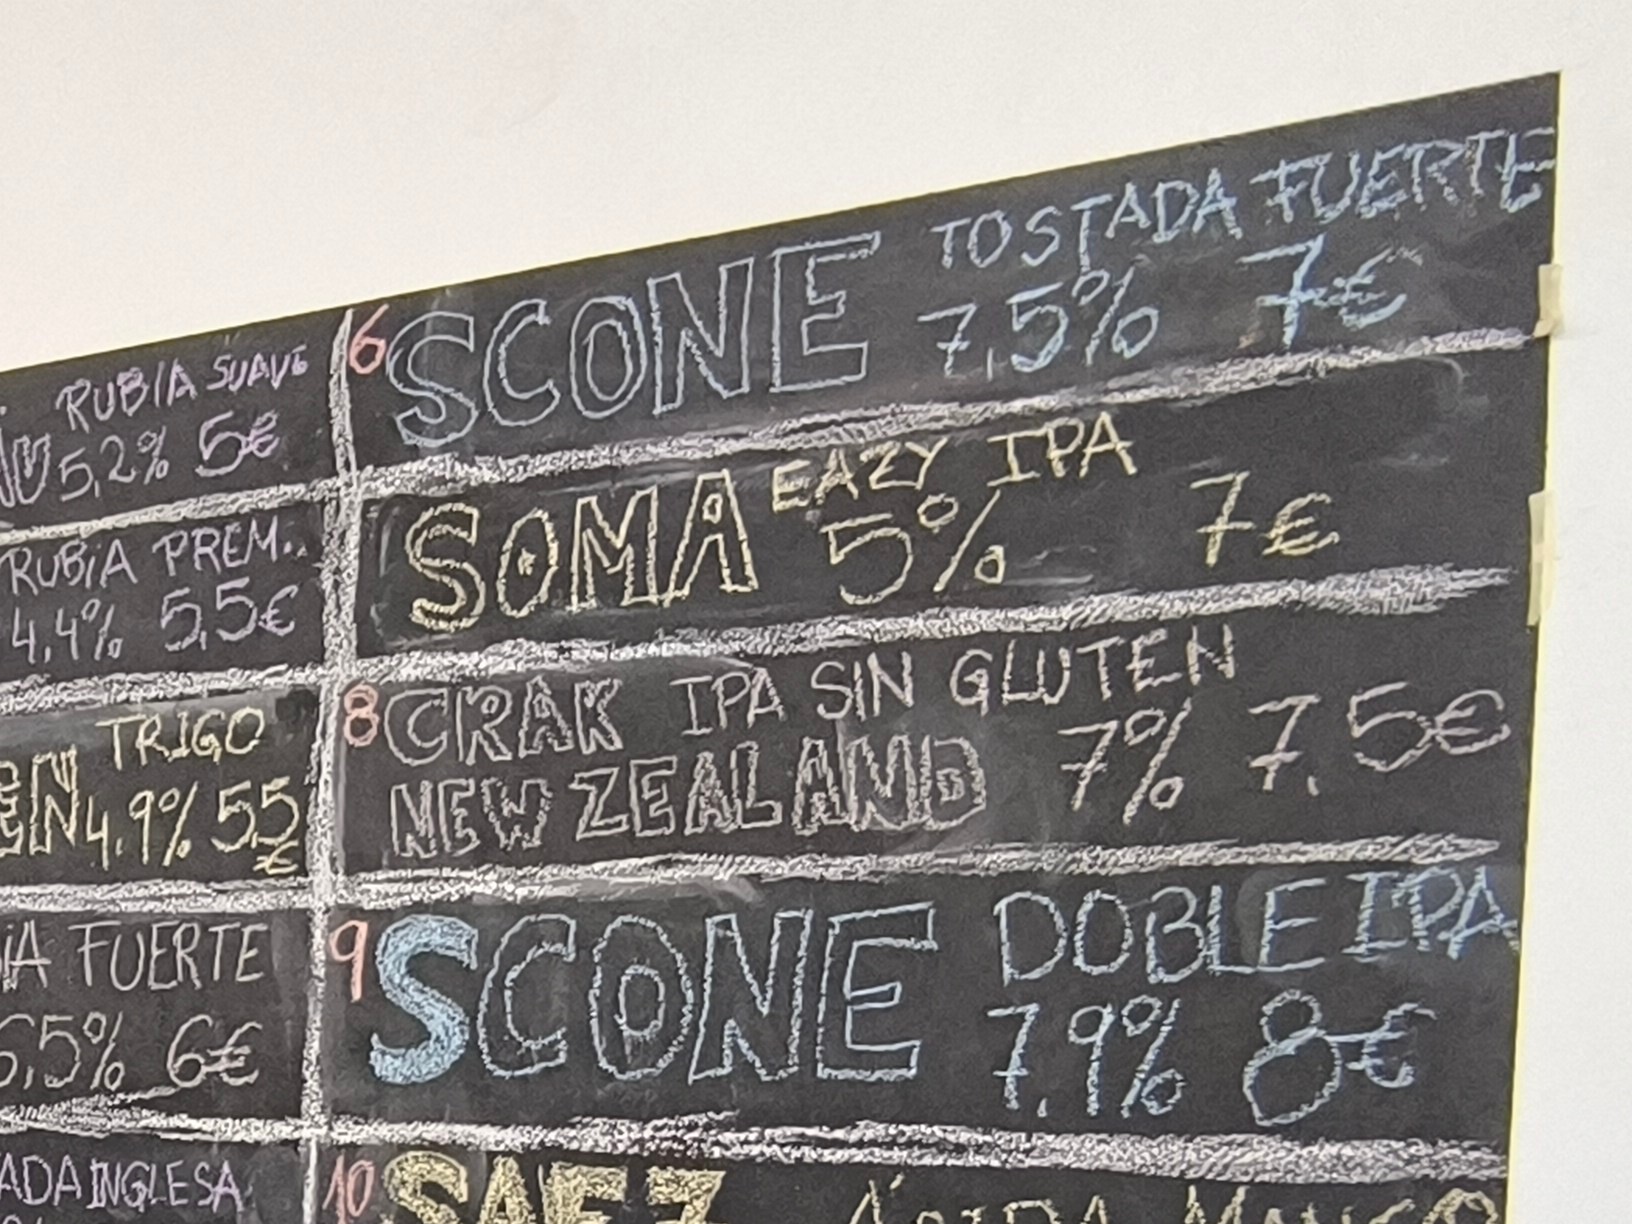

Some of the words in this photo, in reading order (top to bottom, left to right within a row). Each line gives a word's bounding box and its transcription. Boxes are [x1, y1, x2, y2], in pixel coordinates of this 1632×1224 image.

[931, 167, 1243, 269] TOSTADA
[1249, 127, 1555, 223] FUERTE
[349, 303, 389, 374] 6
[386, 231, 880, 447] SCONE
[918, 266, 1159, 381] 7,5%
[1235, 233, 1423, 351] 7€
[54, 357, 198, 433] RUBIA
[59, 425, 169, 502] 5,2%
[195, 409, 279, 477] 5€
[404, 468, 760, 633] SOMA
[770, 437, 949, 512] EAZY
[985, 411, 1139, 487] IPA
[820, 491, 1006, 605] 5%
[1190, 471, 1340, 567] 7€
[159, 576, 299, 652] 5,5€
[95, 706, 264, 770] TRIGO
[342, 684, 380, 747] 8
[383, 675, 624, 766] CRAK
[670, 668, 785, 736] IPA
[810, 652, 914, 721] SIN
[949, 623, 1236, 716] GLUTEN
[86, 780, 199, 870] 4,9%
[390, 778, 553, 859] NEW
[568, 734, 987, 840] ZEALAND
[1057, 697, 1191, 825] 7%
[66, 919, 267, 991] FUERTE
[328, 920, 368, 1003] 9
[368, 902, 939, 1084] SCONE
[992, 880, 1327, 987] DOBLE
[1341, 864, 1520, 960] IPA
[166, 1014, 264, 1090] 6€
[986, 994, 1187, 1119] 7,9%
[1243, 988, 1437, 1127] 8€
[86, 1158, 248, 1213] INGLESA
